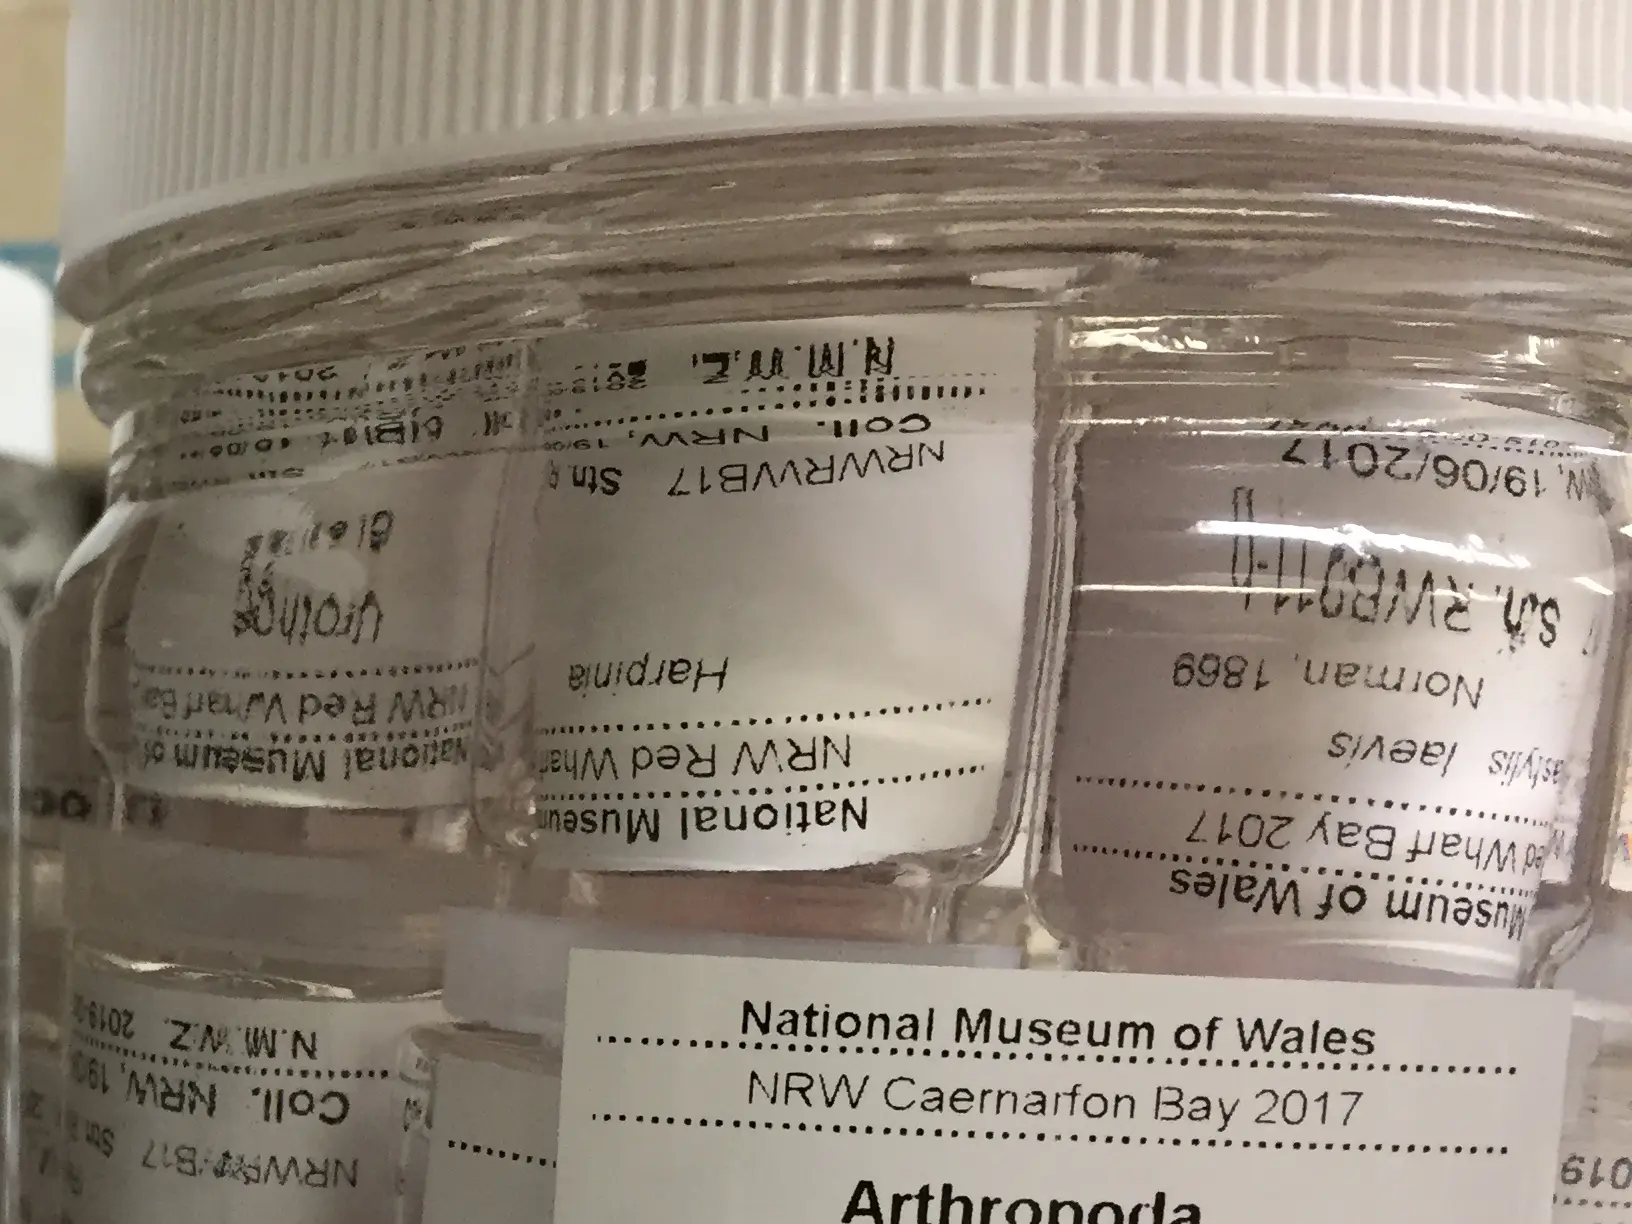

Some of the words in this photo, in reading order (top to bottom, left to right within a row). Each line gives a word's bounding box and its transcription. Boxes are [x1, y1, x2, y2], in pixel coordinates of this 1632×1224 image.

[815, 413, 932, 438] Coll.
[667, 440, 945, 497] NRWRWB17
[567, 652, 729, 696] Harpinia
[1172, 653, 1271, 692] 1869
[1292, 652, 1483, 711] Norman,
[299, 691, 376, 726] Red
[632, 743, 716, 778] Red
[731, 734, 852, 774] NRW
[1327, 731, 1459, 778] laevis
[680, 796, 868, 841] National
[1186, 809, 1295, 849] 2017
[1305, 812, 1396, 861] Bay
[1404, 828, 1518, 874] Wharf
[1168, 868, 1300, 918] Wales
[1315, 882, 1367, 919] of
[742, 1000, 936, 1044] National
[955, 1007, 1155, 1051] Museum
[1173, 1016, 1225, 1052] of
[1235, 1017, 1376, 1056] Wales
[250, 1088, 350, 1125] Coll.
[748, 1071, 868, 1110] NRW
[884, 1075, 1136, 1120] Caernarfon
[1155, 1085, 1240, 1131] Bay
[1254, 1087, 1364, 1127] 2017
